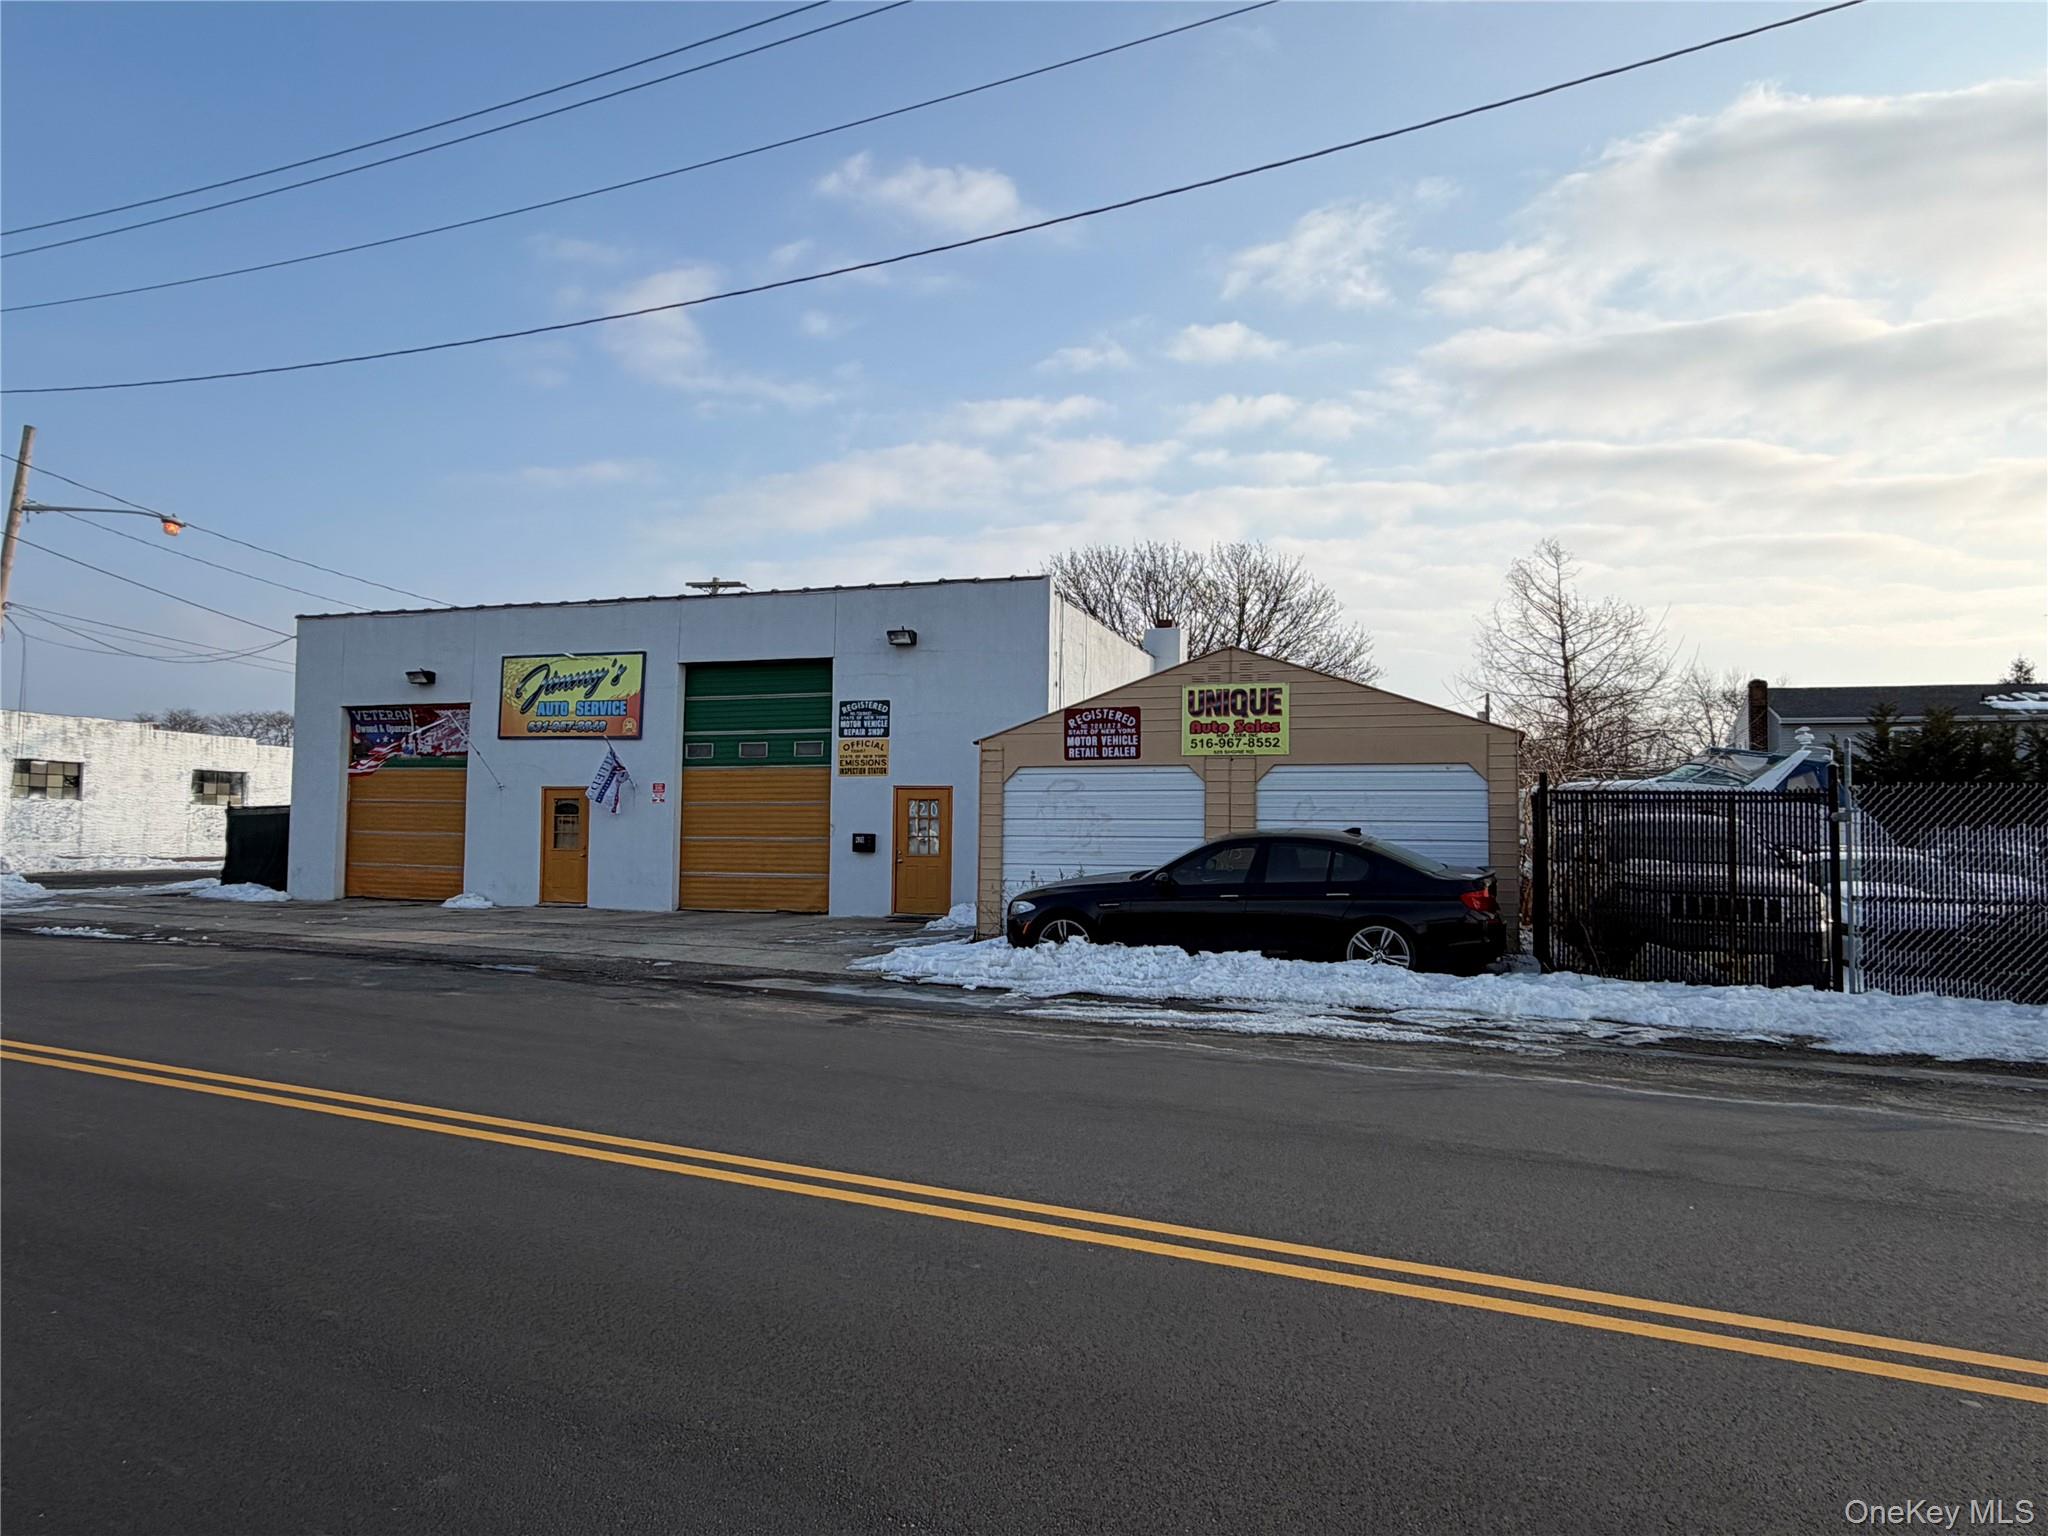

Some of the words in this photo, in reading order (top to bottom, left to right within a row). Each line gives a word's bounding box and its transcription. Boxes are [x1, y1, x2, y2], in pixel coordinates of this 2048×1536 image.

[515, 658, 627, 714] Jimmy's
[536, 701, 569, 716] AUTO
[575, 700, 627, 716] SERVICE
[841, 701, 889, 714] REGISTERED
[1187, 687, 1283, 718] UNIQUE
[840, 720, 861, 728] MOTOR
[864, 720, 888, 728] VEHICLE
[1068, 709, 1136, 728] REGISTERED
[1190, 720, 1230, 734] Auto
[1234, 719, 1281, 733] Sales
[842, 740, 885, 752] OFFICIAL
[1067, 736, 1098, 747] MOTOR
[1101, 735, 1138, 746] VEHICLE
[1190, 737, 1280, 749] 516-967-8552
[1068, 747, 1099, 758] RETAIL
[1102, 746, 1136, 757] DEALER
[840, 759, 887, 767] EMISSIONS
